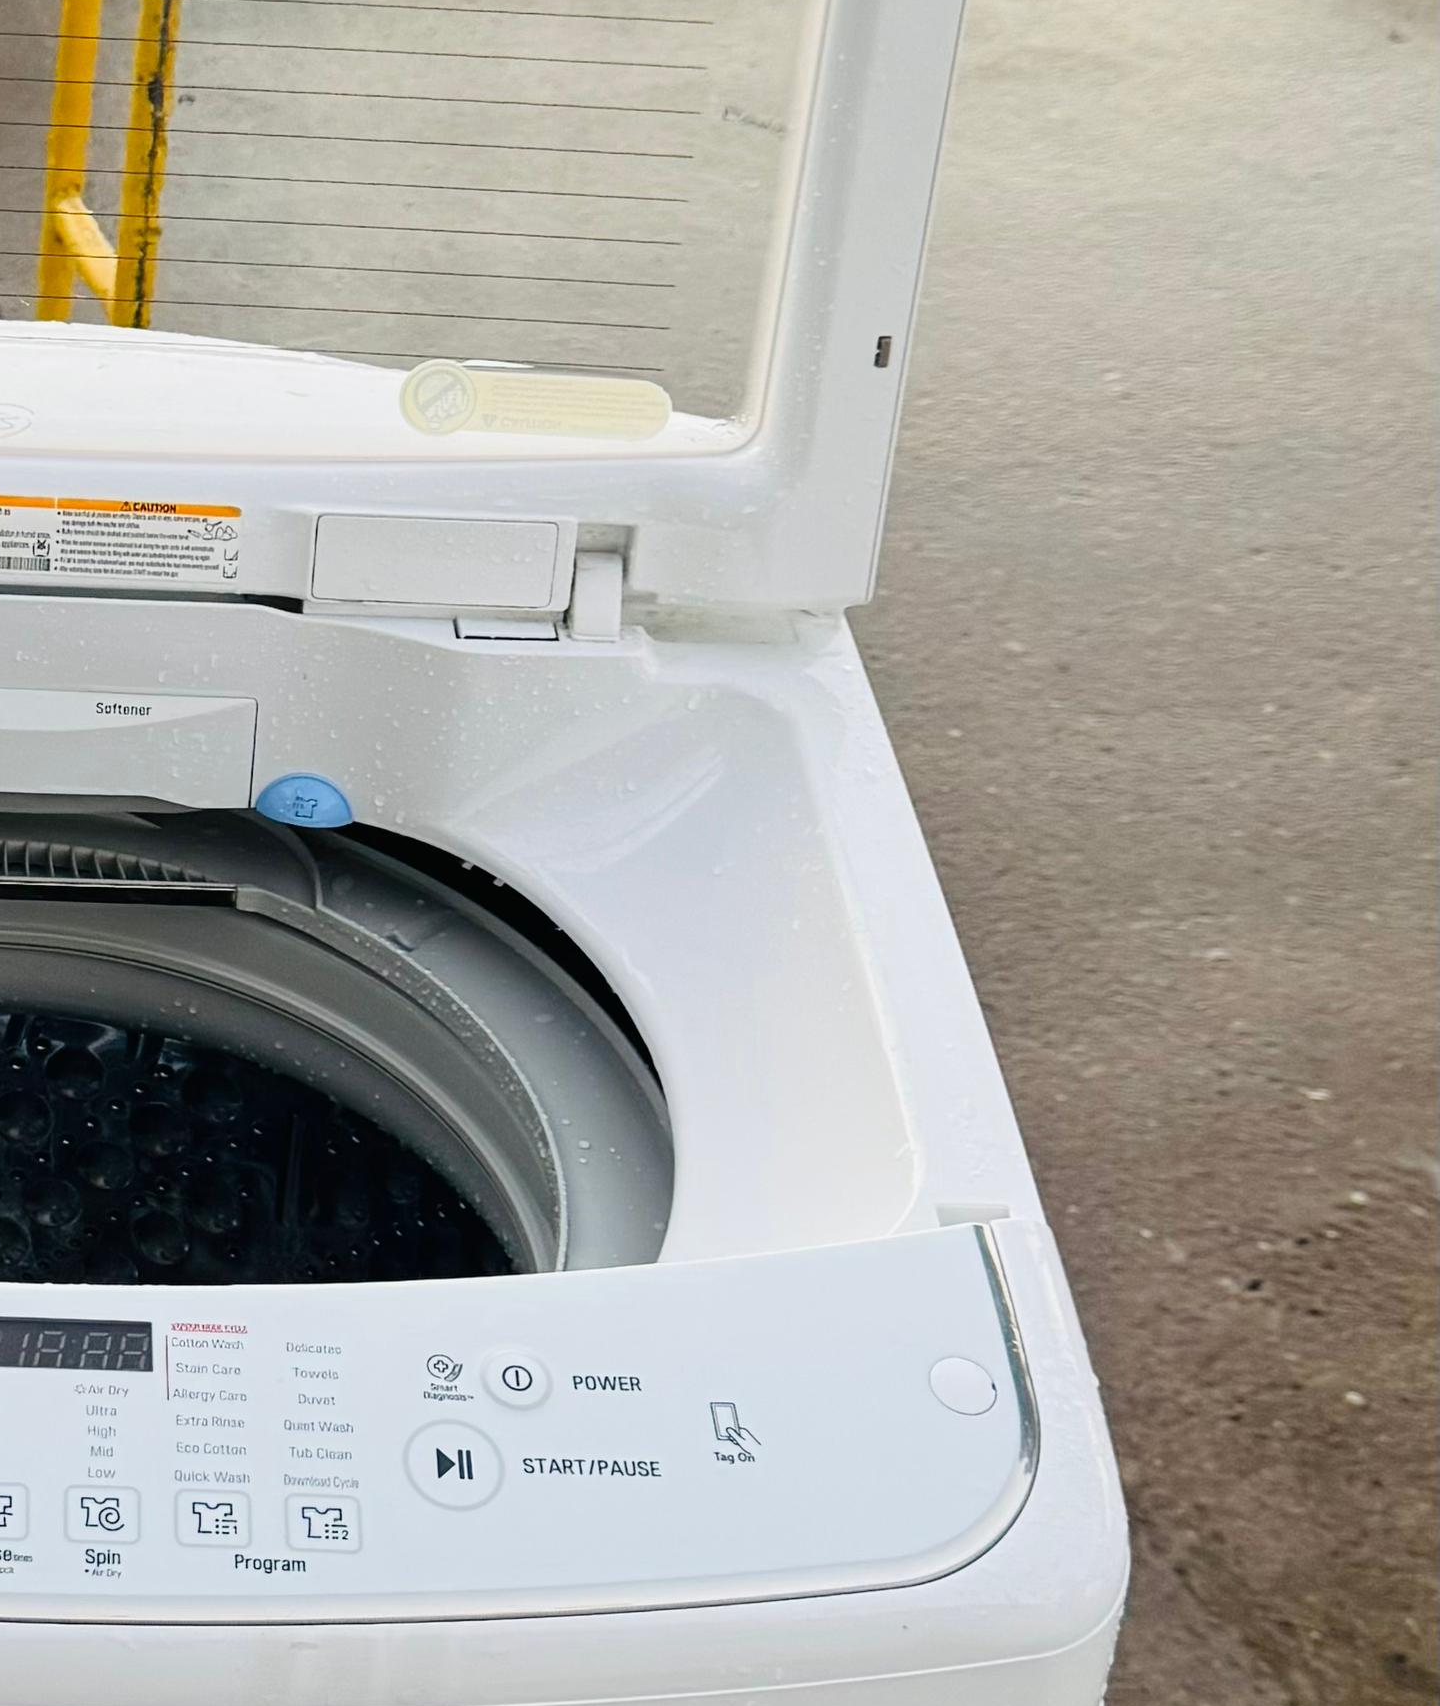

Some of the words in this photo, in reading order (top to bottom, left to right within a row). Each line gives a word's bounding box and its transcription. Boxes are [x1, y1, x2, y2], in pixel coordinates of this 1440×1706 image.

[133, 502, 177, 514] CAUTION
[96, 702, 152, 716] Softener
[171, 1336, 209, 1349] Cotton
[212, 1339, 245, 1350] Wash
[175, 1362, 208, 1374] Stain
[212, 1364, 241, 1375] Care
[292, 1367, 340, 1380] Towels
[88, 1384, 104, 1395] Air
[108, 1385, 129, 1397] Dry
[572, 1375, 642, 1392] POWER
[173, 1388, 216, 1402] Allergy
[219, 1390, 248, 1402] Care
[86, 1404, 117, 1416] Ultra
[175, 1415, 208, 1427] Extra
[212, 1416, 245, 1429] Rinse
[318, 1421, 354, 1434] Wash
[87, 1425, 117, 1439] High
[90, 1445, 114, 1457] Mid
[176, 1442, 200, 1454] Eco
[203, 1443, 247, 1456] Cotton
[289, 1446, 313, 1459] Tub
[317, 1448, 352, 1460] Clean
[714, 1452, 735, 1464] Tag
[738, 1452, 756, 1463] On
[87, 1466, 116, 1479] Low
[522, 1457, 662, 1478] START/PAUSE
[174, 1469, 210, 1483] Quick
[214, 1471, 250, 1484] Wash
[85, 1548, 121, 1567] Spin
[234, 1554, 307, 1574] Program
